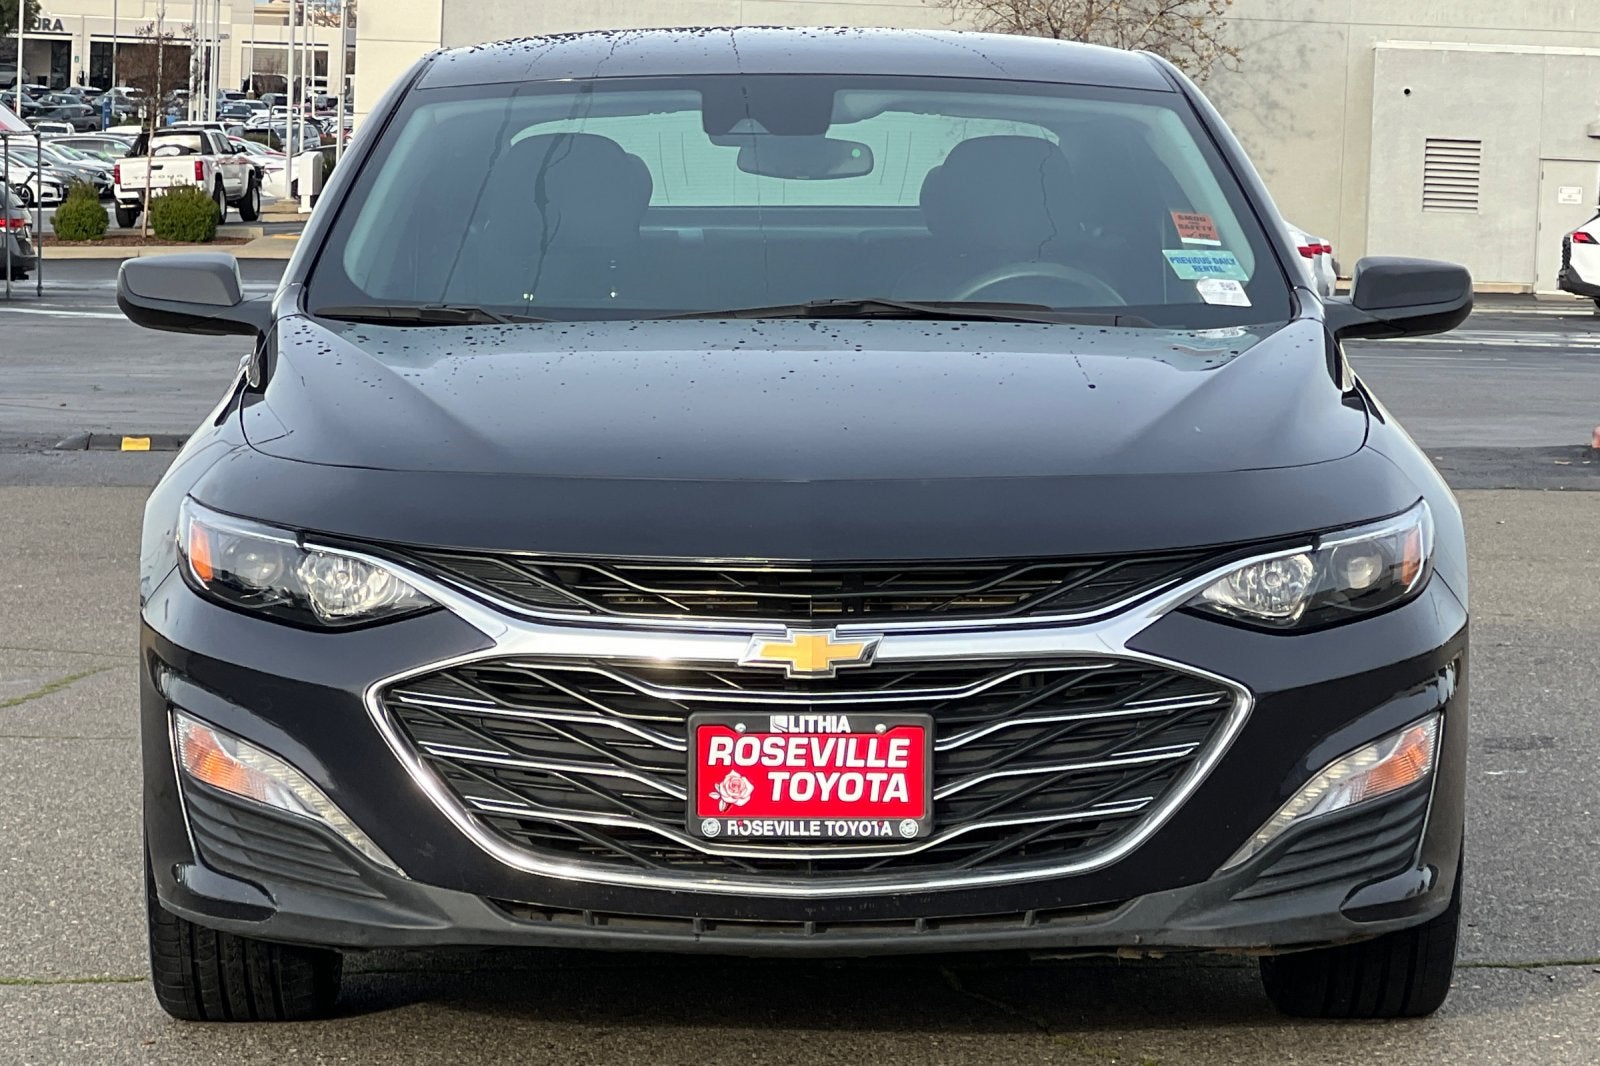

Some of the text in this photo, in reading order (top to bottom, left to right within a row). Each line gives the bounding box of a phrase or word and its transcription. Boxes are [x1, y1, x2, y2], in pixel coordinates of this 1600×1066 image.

[32, 18, 64, 31] URA
[1169, 256, 1236, 266] PREVIOUS DAILY
[1191, 264, 1226, 273] RENTAL
[789, 715, 851, 733] LITHIA
[707, 736, 911, 769] ROSEVILLE
[767, 771, 909, 803] TOYOTA
[727, 820, 893, 836] ROSEVILLE TOYOTA
